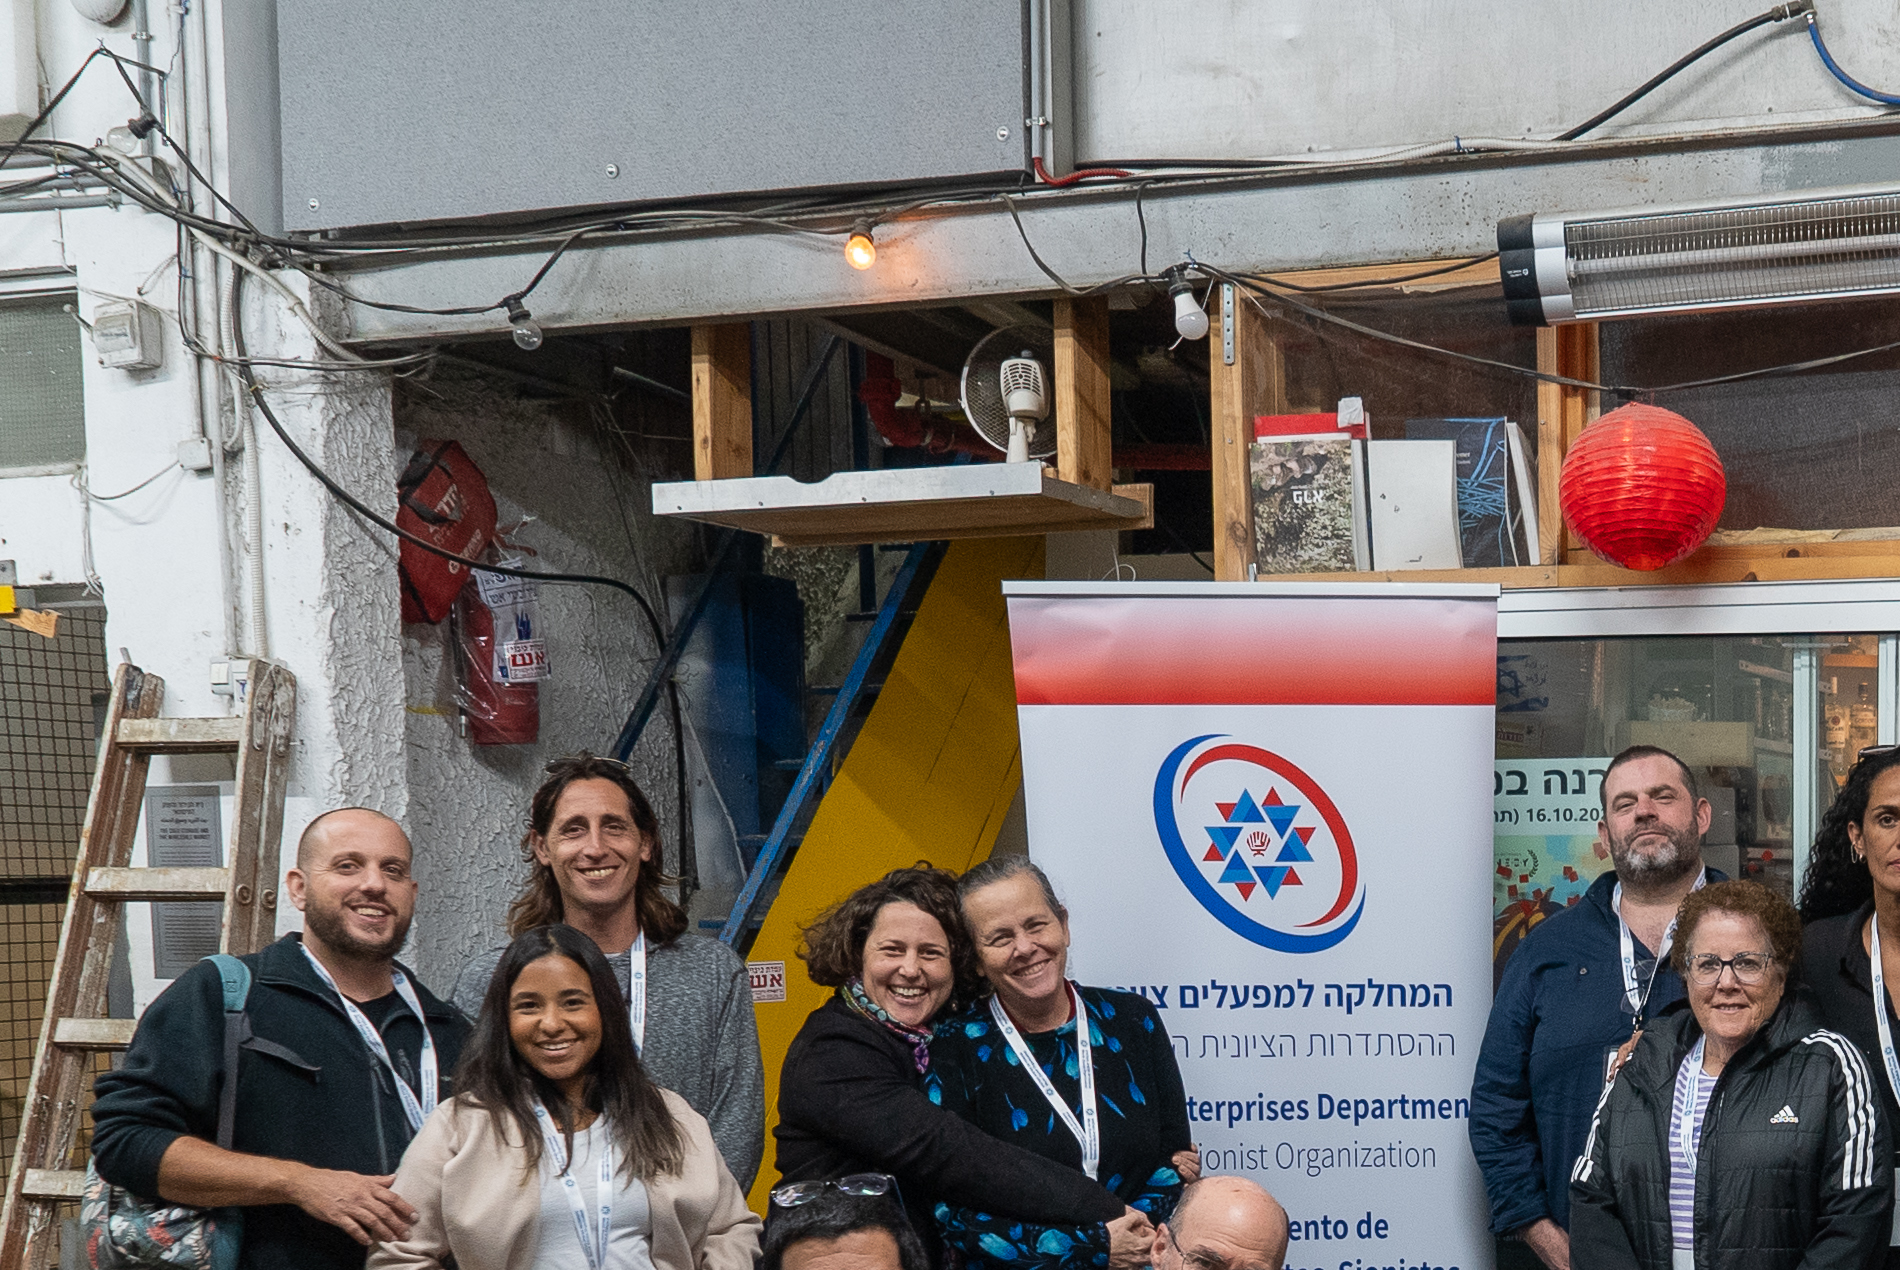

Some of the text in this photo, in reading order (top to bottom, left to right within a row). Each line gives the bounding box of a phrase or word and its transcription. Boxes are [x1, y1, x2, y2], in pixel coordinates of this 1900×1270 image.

[1527, 808, 1604, 822] 16.10.20
[749, 974, 782, 988] אש
[1179, 978, 1313, 1009] למפעלים
[1324, 978, 1453, 1014] המחלקה
[1199, 1032, 1296, 1058] הציונית
[1306, 1032, 1455, 1057] ההסתדרות
[1187, 1093, 1469, 1128] terprises Departmen
[1199, 1141, 1437, 1177] ionist Organization
[1356, 1211, 1389, 1240] de
